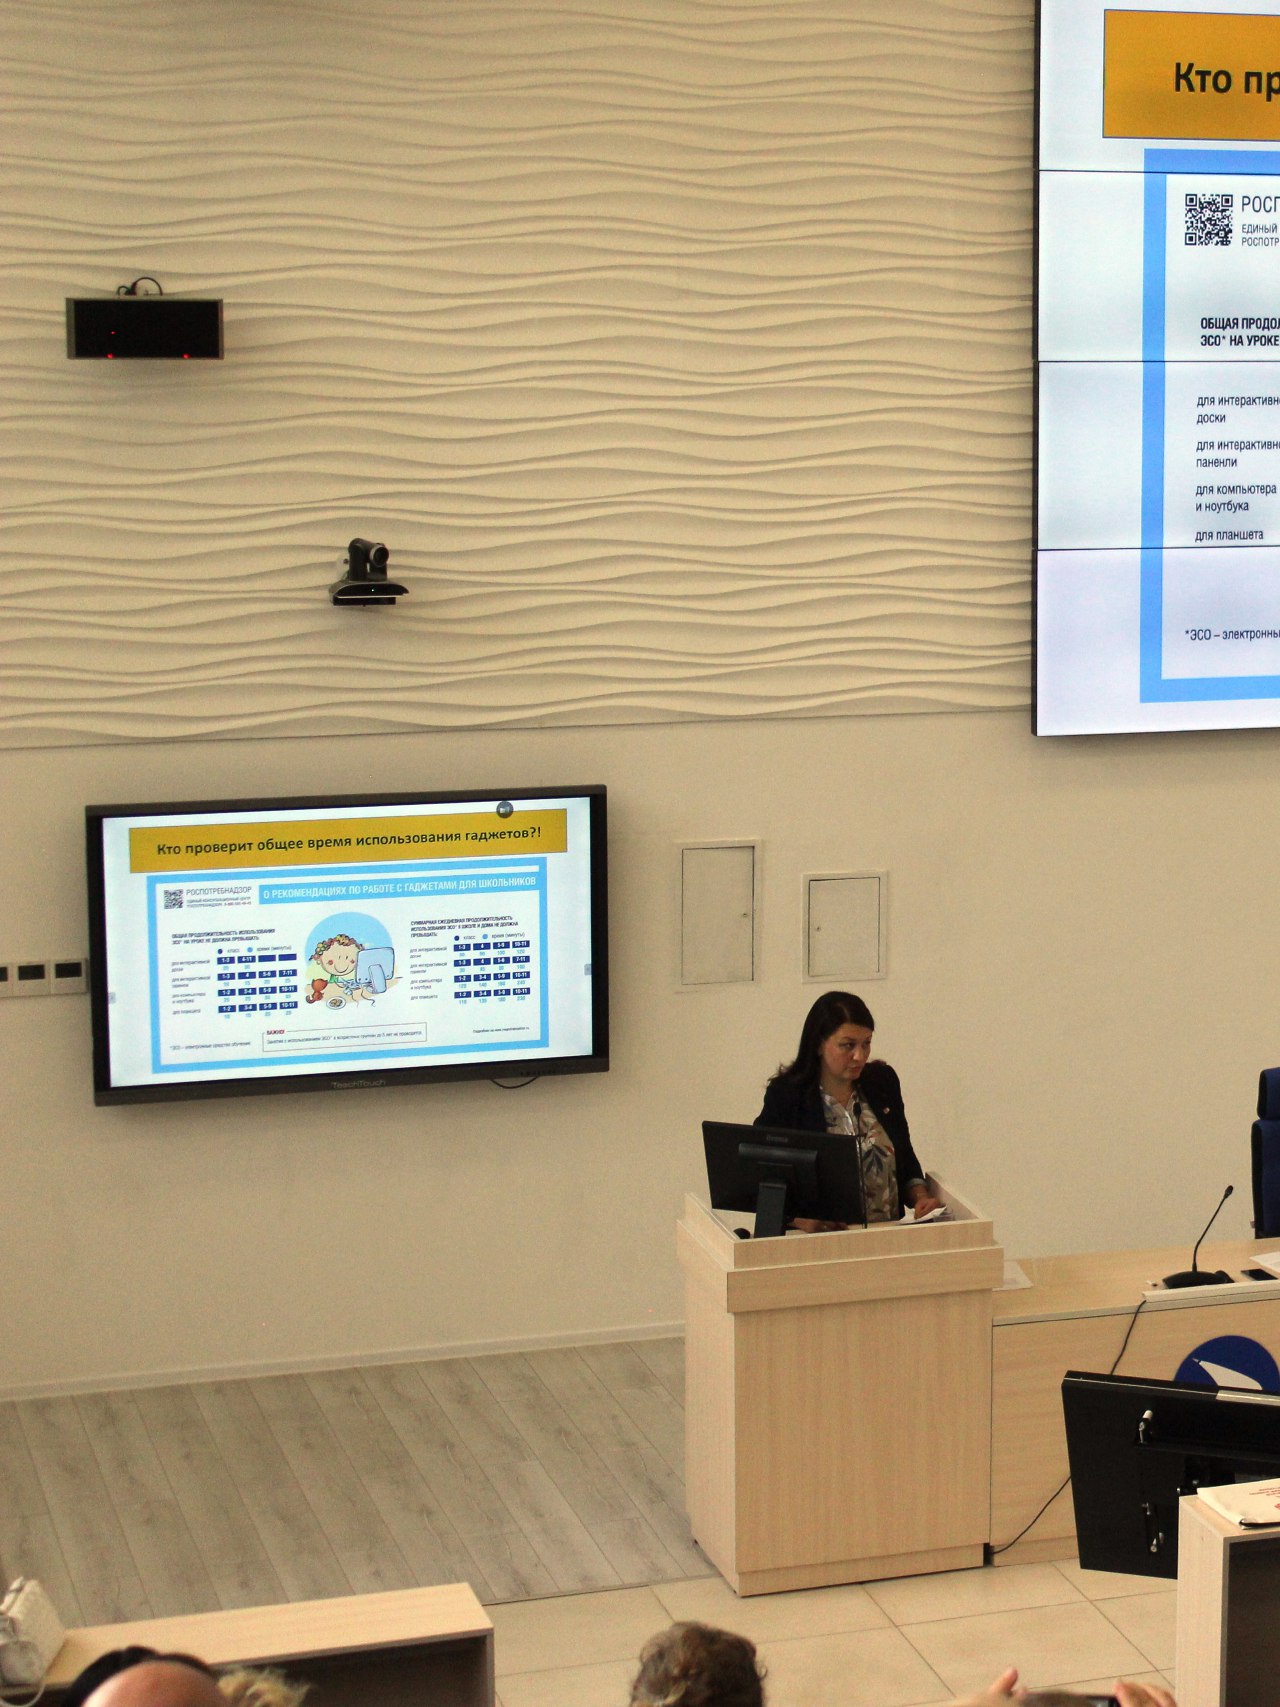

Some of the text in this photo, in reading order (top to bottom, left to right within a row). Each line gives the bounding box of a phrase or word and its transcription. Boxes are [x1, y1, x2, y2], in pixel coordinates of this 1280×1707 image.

[1174, 62, 1232, 94] Кто
[1241, 223, 1278, 235] ЕДИНЫЙ
[1200, 317, 1239, 331] ОБЩАЯ
[1229, 335, 1244, 347] НА
[1246, 335, 1280, 347] УРОКЕ
[1197, 396, 1215, 407] для
[1196, 414, 1226, 425] доски
[1196, 440, 1214, 451] для
[1196, 457, 1238, 468] паненли
[1195, 484, 1277, 497] для компьютера
[1195, 500, 1250, 514] и ноутбука
[1195, 529, 1264, 542] для планшета
[157, 826, 542, 857] Кто проверит общее время использования гаджетов?!
[186, 886, 252, 896] РОСПОТРЕБНАДЗОР
[263, 877, 537, 900] О РЕКОМЕНДАЦИЯХ ПО РАБОТЕ С ГАДЖЕТАМИ ДЛЯ ШКОЛЬНИКОВ
